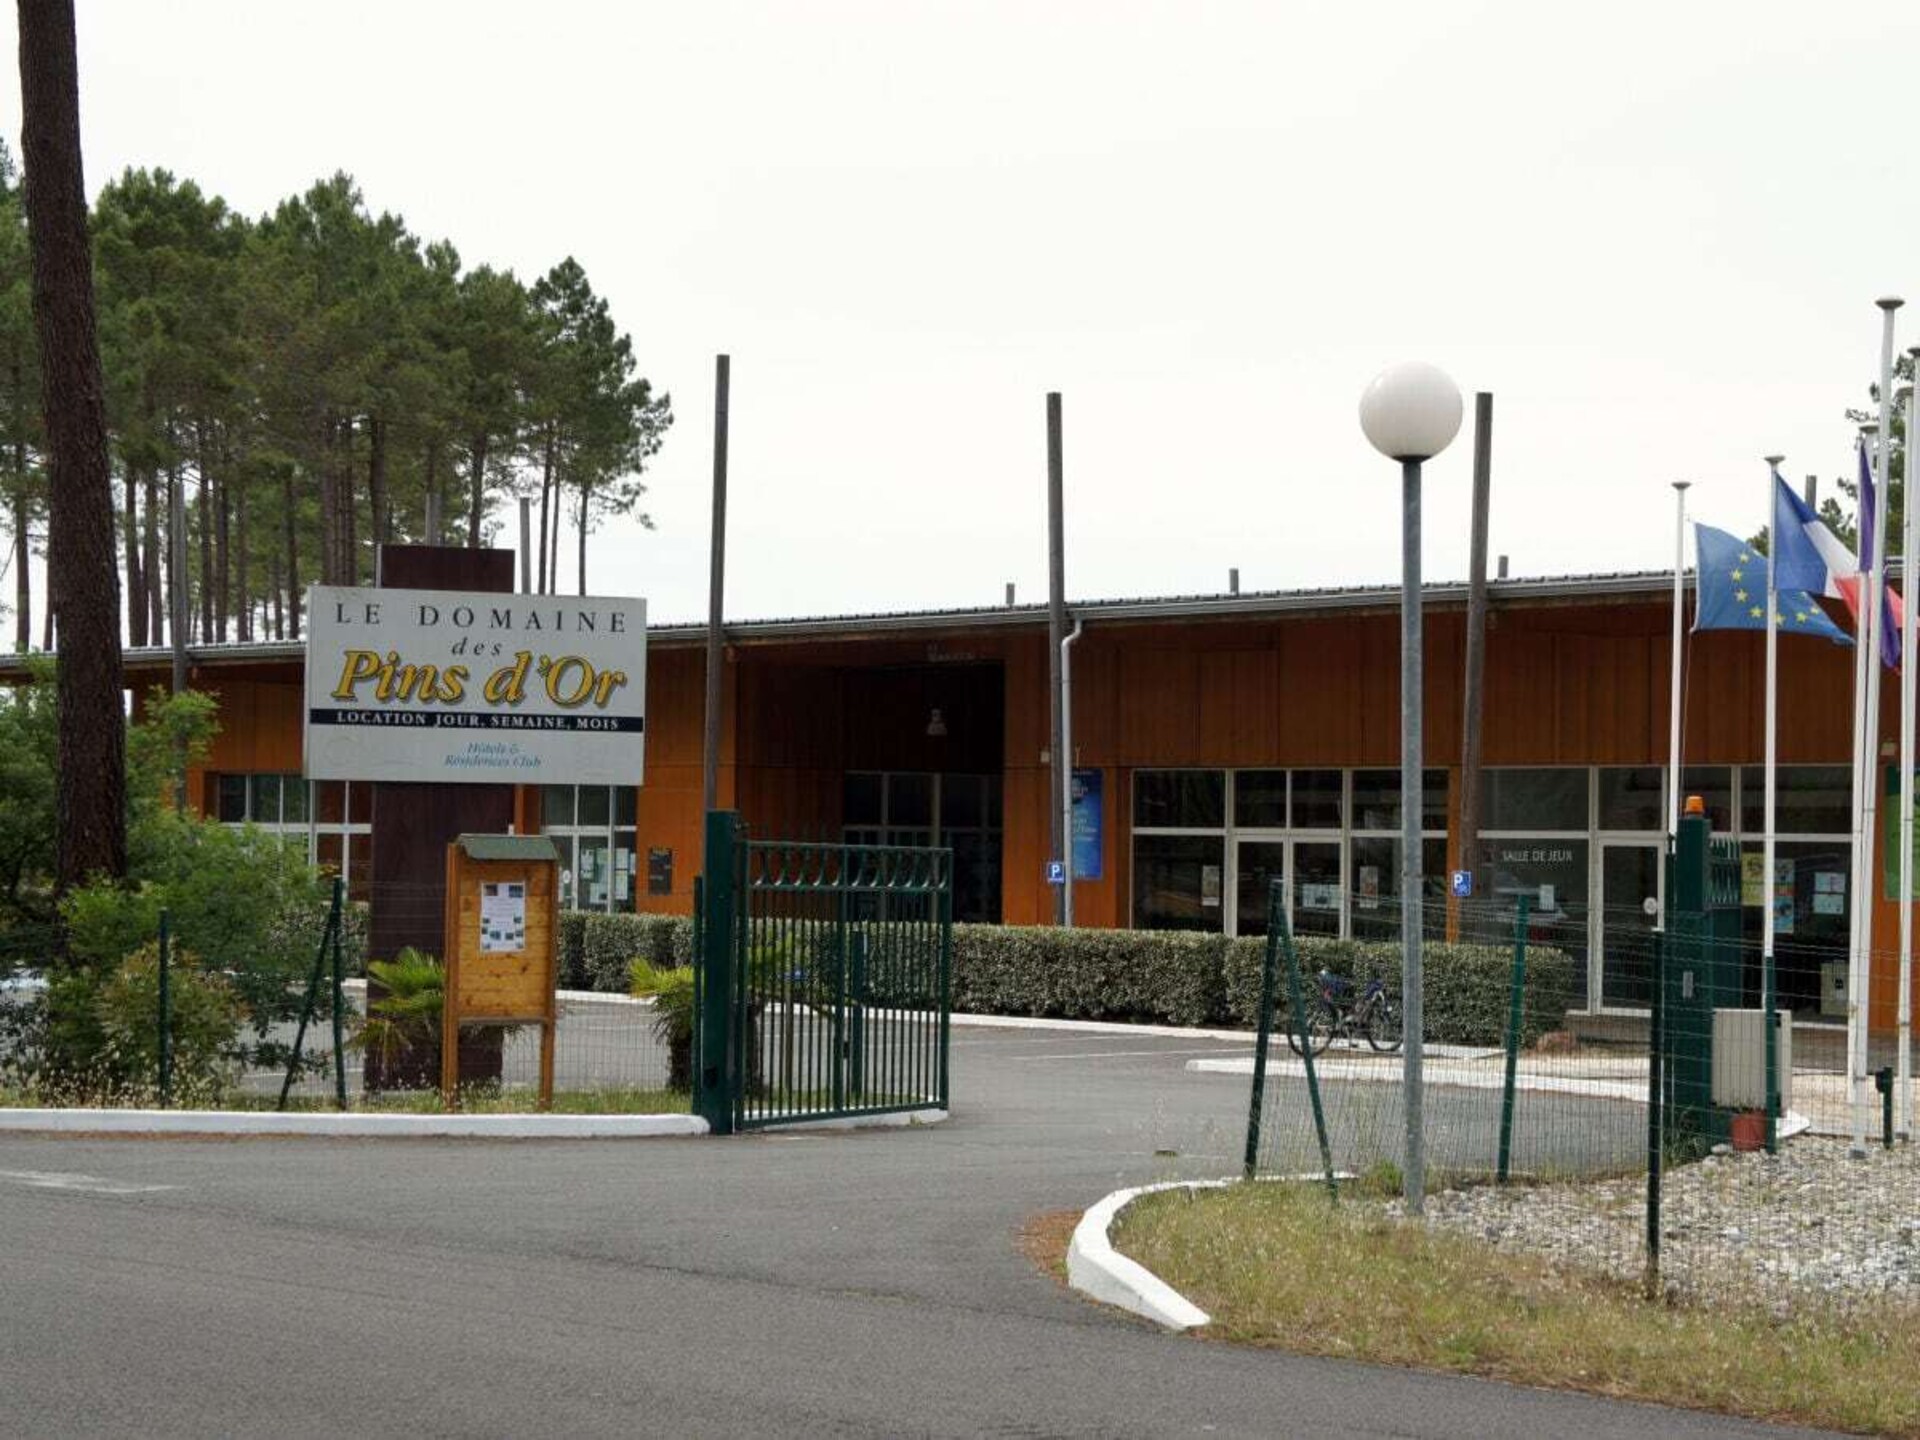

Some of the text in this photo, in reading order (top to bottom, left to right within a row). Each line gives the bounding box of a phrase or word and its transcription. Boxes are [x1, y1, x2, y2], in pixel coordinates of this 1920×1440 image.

[336, 603, 625, 632] LE DOMAINE
[452, 637, 502, 656] des
[331, 650, 627, 708] Pins d'Or
[337, 711, 425, 725] LOCATION
[577, 718, 618, 730] MOIS
[1532, 850, 1545, 861] DE
[1052, 864, 1060, 877] P
[1453, 873, 1463, 888] P
